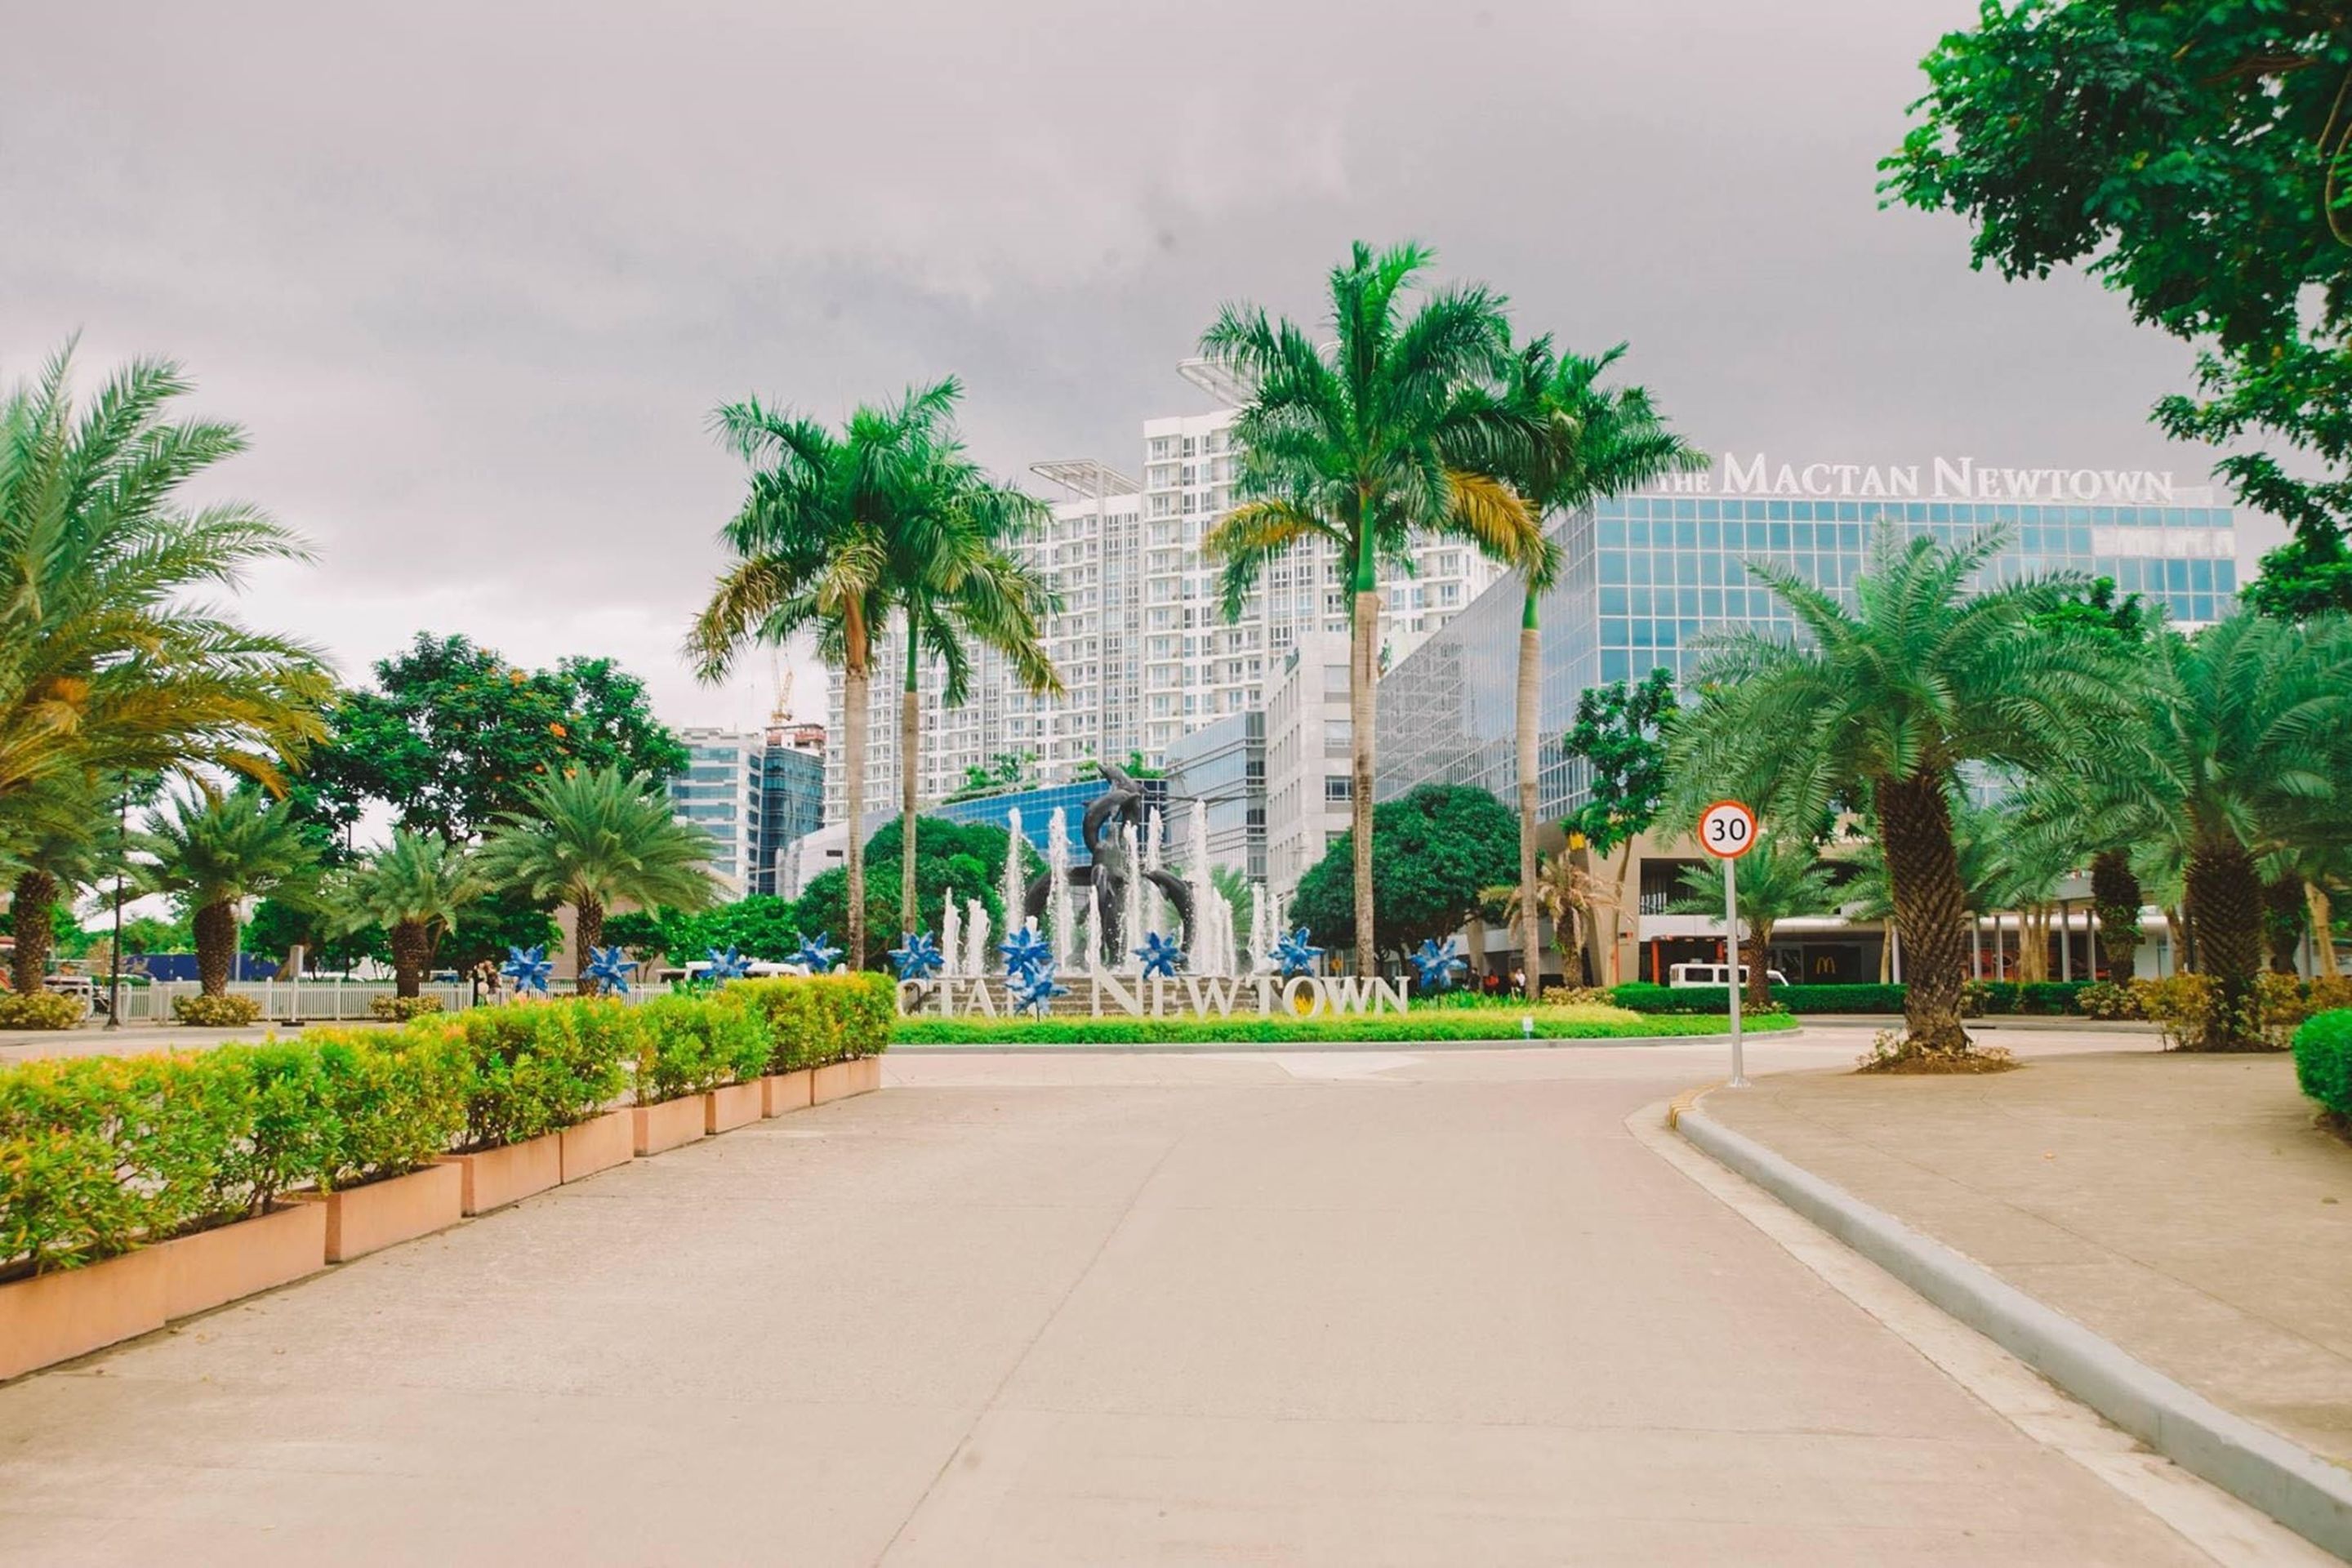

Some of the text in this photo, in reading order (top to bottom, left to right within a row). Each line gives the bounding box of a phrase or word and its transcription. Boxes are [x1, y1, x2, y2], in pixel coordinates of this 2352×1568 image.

[1720, 452, 1920, 497] MACTAN
[1930, 456, 2174, 503] NEWTOWN
[1712, 818, 1746, 841] 30
[1089, 961, 1411, 1019] NEWTOWN
